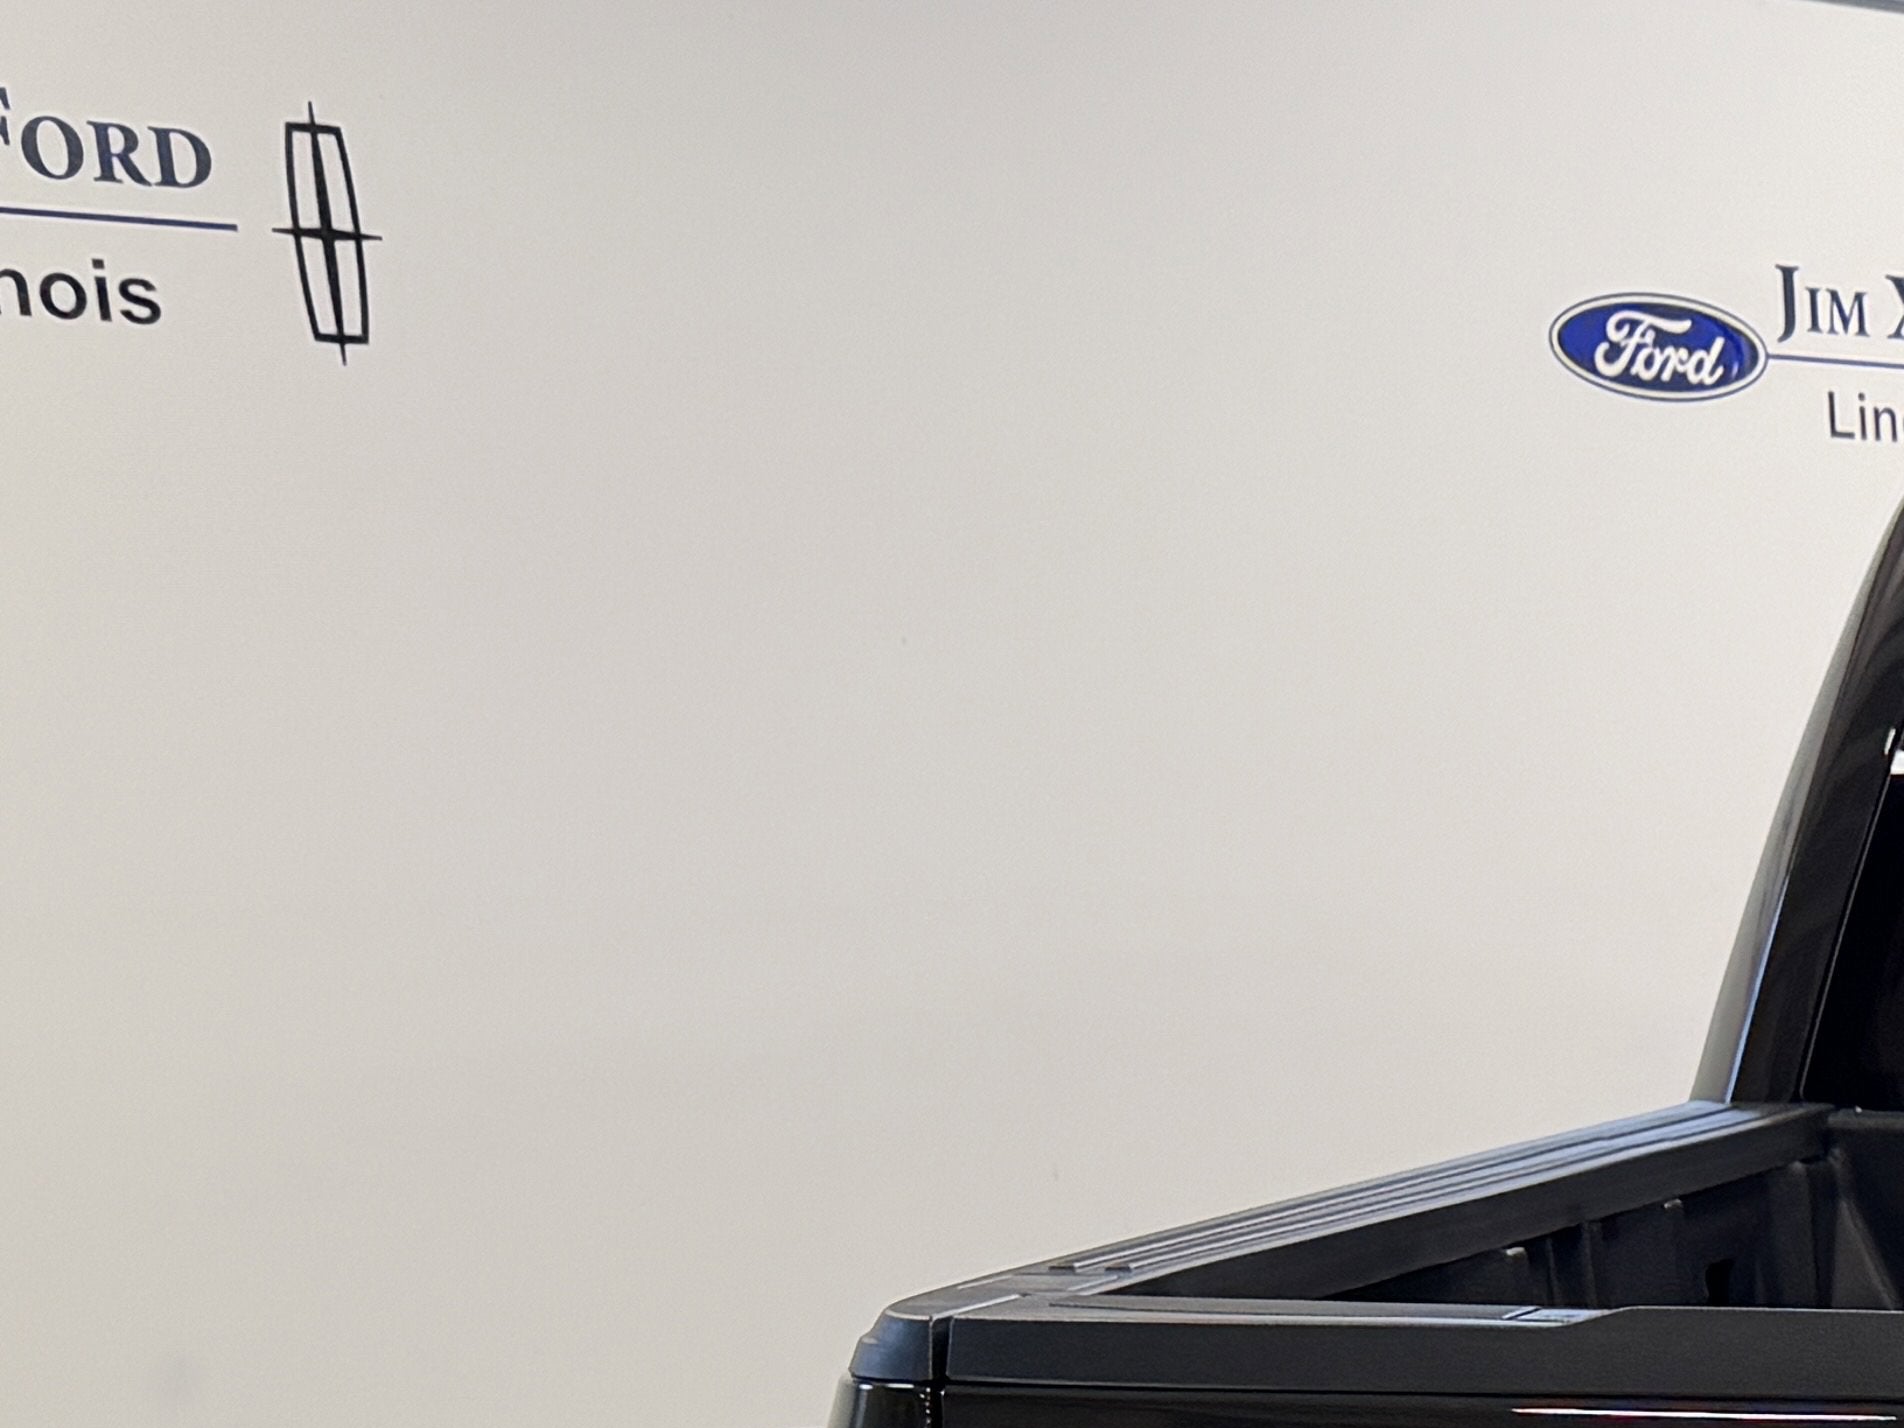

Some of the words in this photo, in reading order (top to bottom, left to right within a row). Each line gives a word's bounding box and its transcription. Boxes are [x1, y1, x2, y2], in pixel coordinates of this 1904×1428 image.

[0, 87, 212, 189] ORD
[0, 257, 162, 325] nois
[1594, 310, 1727, 386] Ford
